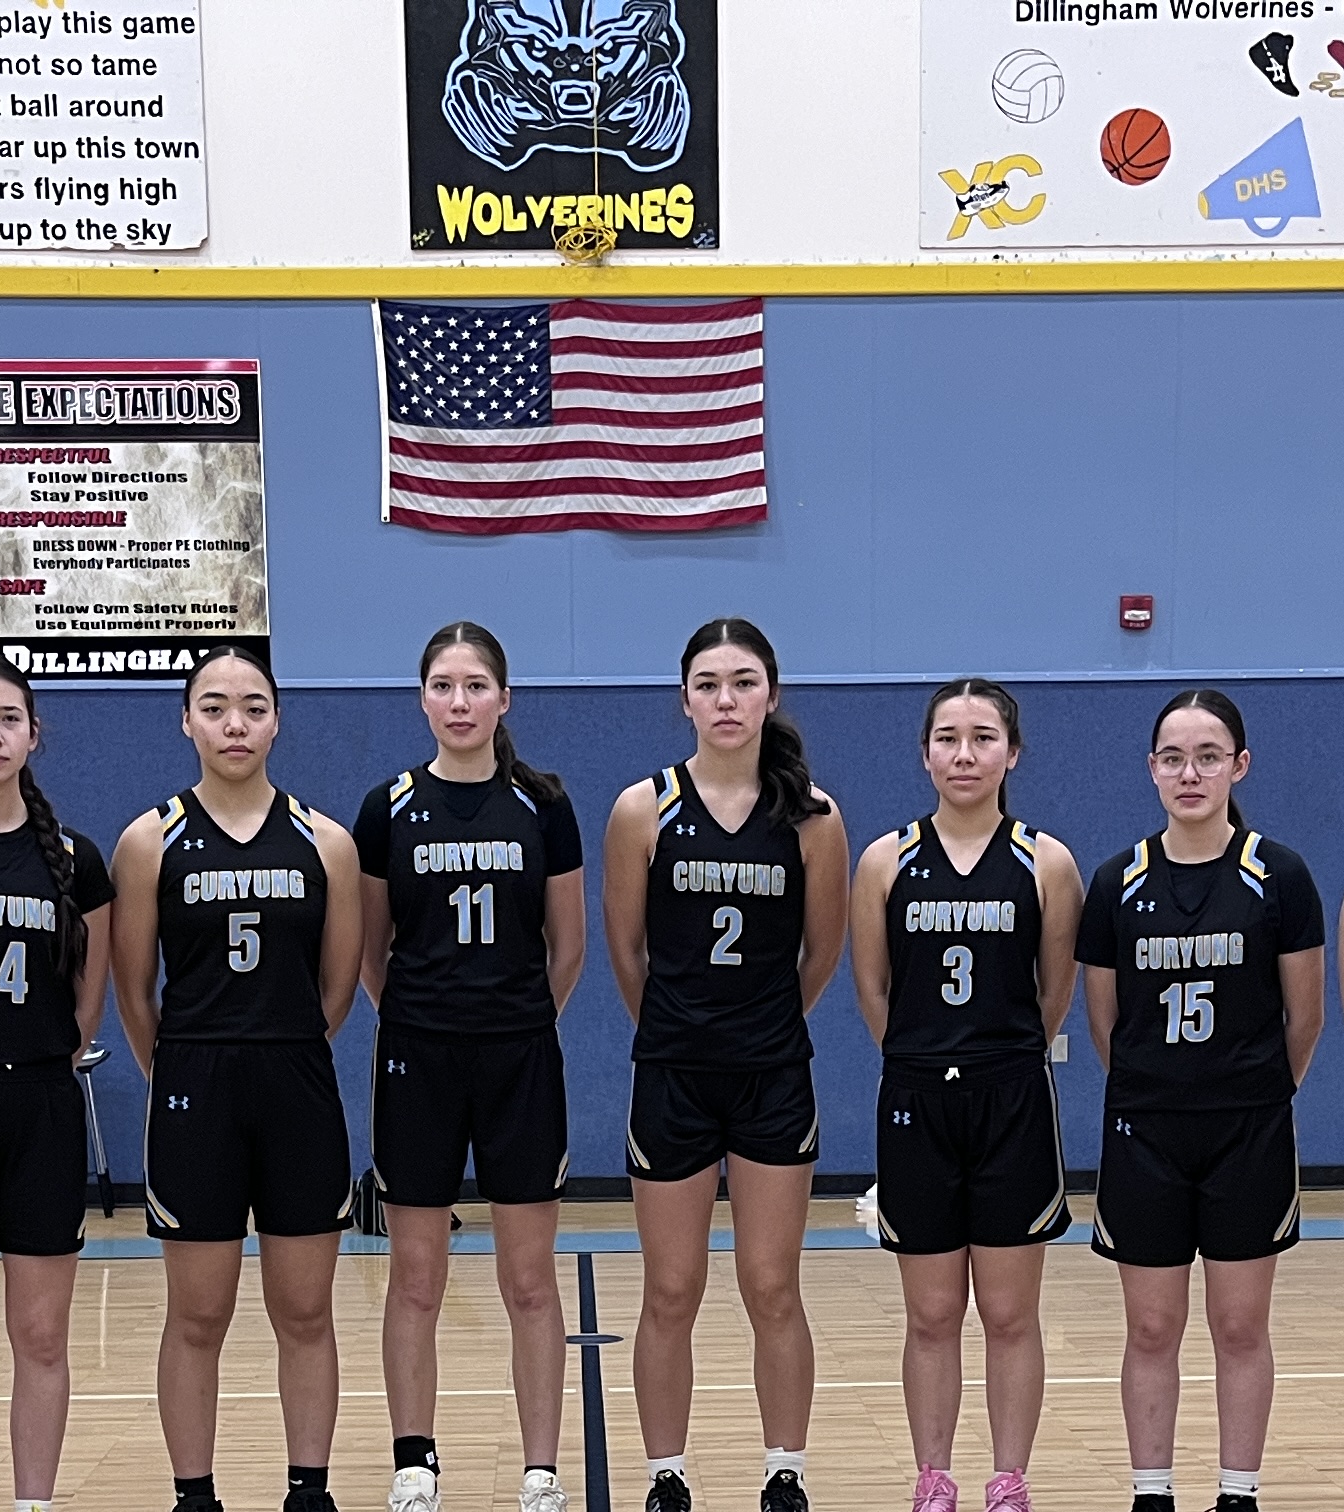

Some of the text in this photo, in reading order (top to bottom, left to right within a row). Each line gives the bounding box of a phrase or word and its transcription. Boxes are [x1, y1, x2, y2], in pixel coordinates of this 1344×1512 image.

[62, 12, 112, 34] this
[123, 16, 195, 39] game
[1016, 0, 1157, 26] Dillingham
[1171, 0, 1314, 19] Wolverines
[51, 58, 83, 76] so
[92, 54, 158, 76] tame
[11, 94, 58, 117] ball
[69, 95, 164, 117] around
[34, 141, 67, 164] up
[76, 136, 126, 158] this
[135, 137, 200, 159] town
[34, 177, 109, 206] flying
[119, 178, 177, 206] high
[938, 154, 1047, 241] XC
[1235, 170, 1287, 202] DHS
[437, 183, 694, 243] WOLVERINES
[0, 223, 32, 246] up
[40, 219, 67, 240] to
[76, 218, 117, 240] the
[127, 218, 172, 245] sky
[21, 380, 241, 425] EXPECTATIONS
[27, 471, 188, 484] Follow Directions
[30, 490, 149, 502] Stay Positive
[33, 540, 75, 552] DRESS
[77, 540, 117, 552] DOWN
[128, 540, 173, 553] Proper
[175, 540, 191, 551] PE
[193, 539, 251, 553] Clothing
[33, 557, 191, 571] Everybody Participates
[34, 603, 238, 616] Follow Gym Safety Rules
[35, 620, 237, 632] Use Equipment Properly
[3, 645, 210, 673] DILLINGHA
[413, 841, 523, 875] CURYUNG
[183, 869, 305, 904] CURYUNG
[672, 860, 786, 896] CURYUNG
[448, 883, 495, 944] 11
[905, 900, 1015, 933] CURYUNG
[228, 911, 260, 972] 5
[709, 905, 744, 966] 2
[1135, 932, 1244, 971] CURYUNG
[941, 945, 974, 1006] 3
[1159, 980, 1216, 1043] 15
